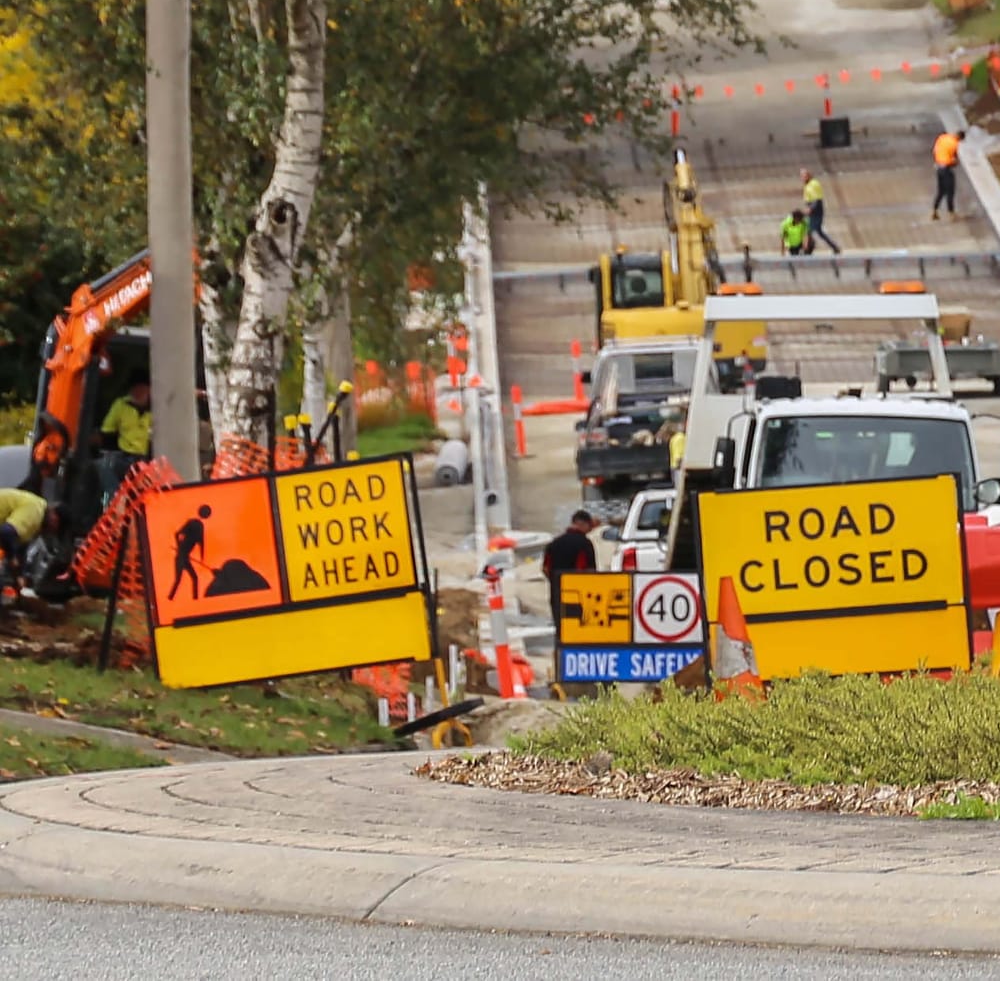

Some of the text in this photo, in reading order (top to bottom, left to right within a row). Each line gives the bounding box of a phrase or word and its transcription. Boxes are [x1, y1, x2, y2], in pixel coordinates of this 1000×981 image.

[103, 270, 153, 318] HITACH
[294, 474, 386, 511] ROAD
[297, 512, 393, 549] WORK
[764, 503, 896, 543] ROAD
[303, 551, 400, 589] AHEAD
[740, 549, 929, 593] CLOSED
[647, 593, 691, 623] 40
[565, 653, 619, 677] DRIVE
